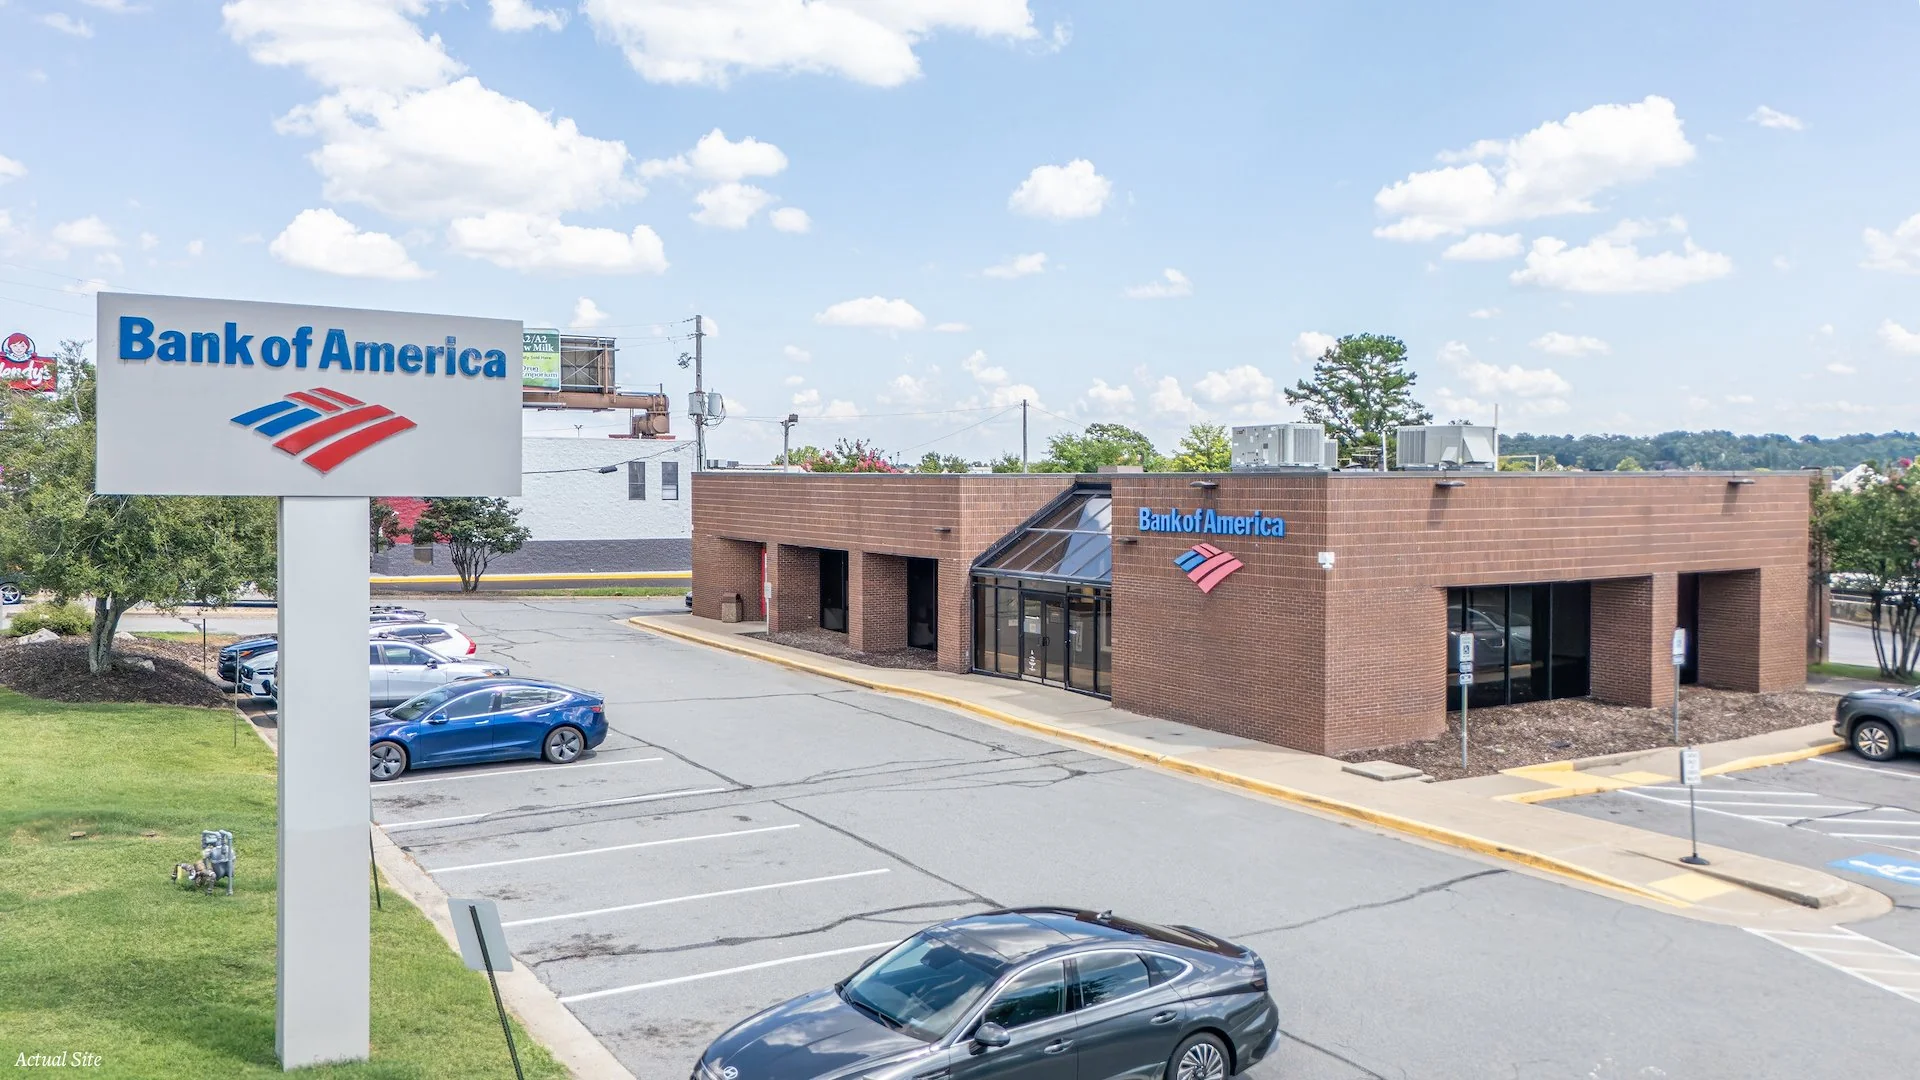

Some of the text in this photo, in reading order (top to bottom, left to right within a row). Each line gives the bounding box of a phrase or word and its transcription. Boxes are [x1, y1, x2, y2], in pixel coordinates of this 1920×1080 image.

[120, 316, 507, 378] Bank of America
[523, 335, 547, 343] 2/A2
[533, 344, 554, 352] Milk
[0, 360, 53, 386] endy's
[1138, 507, 1286, 538] Bank of America
